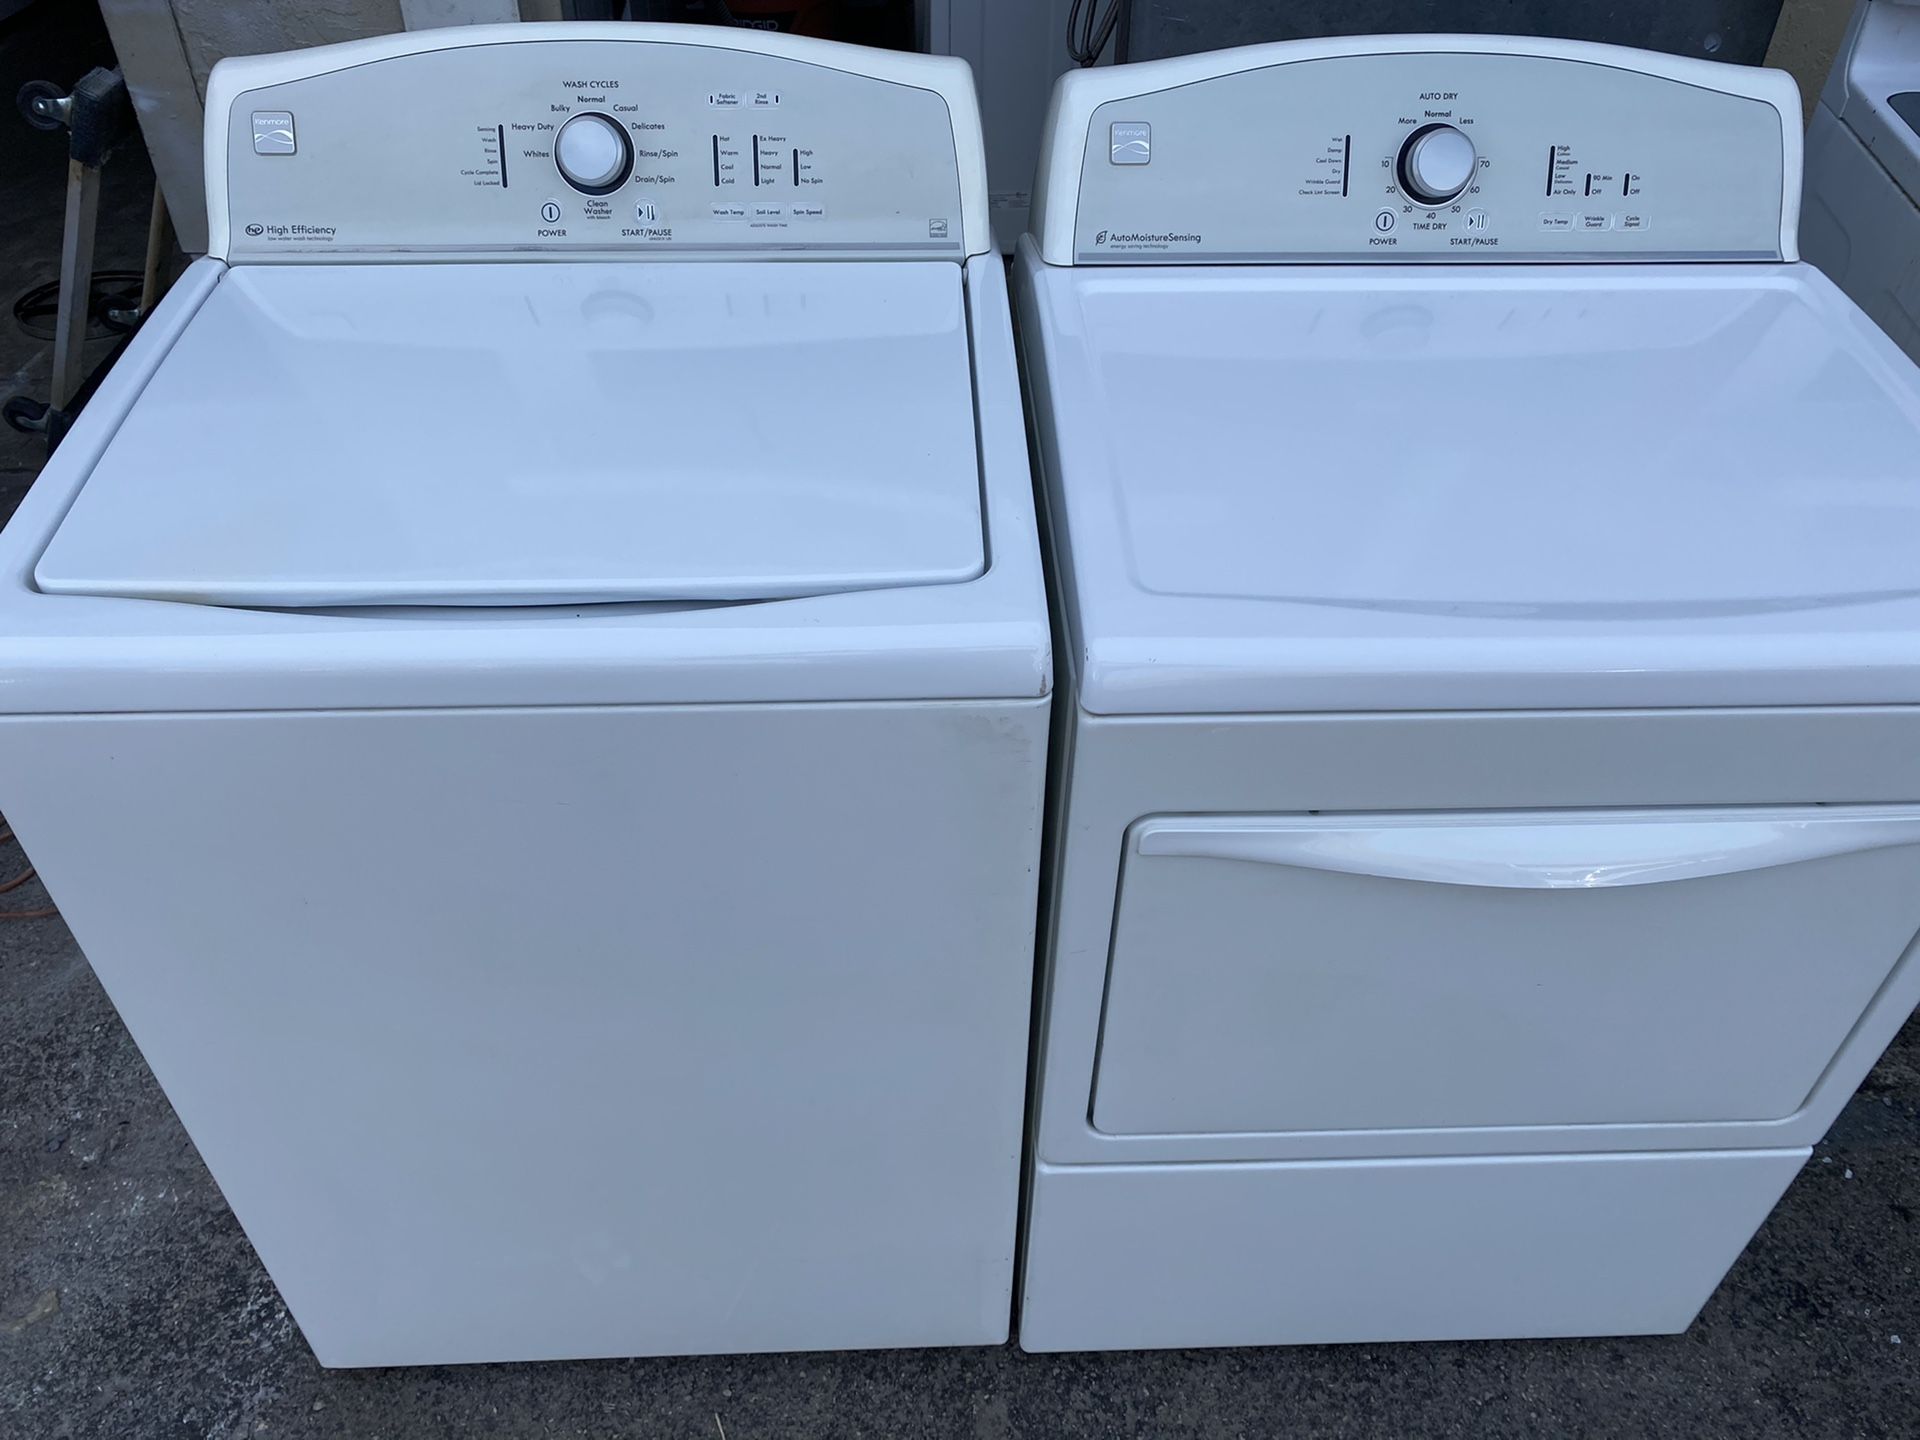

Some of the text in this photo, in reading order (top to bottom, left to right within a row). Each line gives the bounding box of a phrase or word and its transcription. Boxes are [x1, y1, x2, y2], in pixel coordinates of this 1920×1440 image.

[640, 150, 678, 159] Rinse/Spin
[635, 175, 675, 184] Drain/Spin
[267, 225, 288, 235] High
[292, 225, 336, 235] Efficiency
[622, 229, 672, 237] START/PAUSE
[1110, 233, 1201, 243] AutoMoistureSensing
[1450, 238, 1498, 246] START/PAUSE
